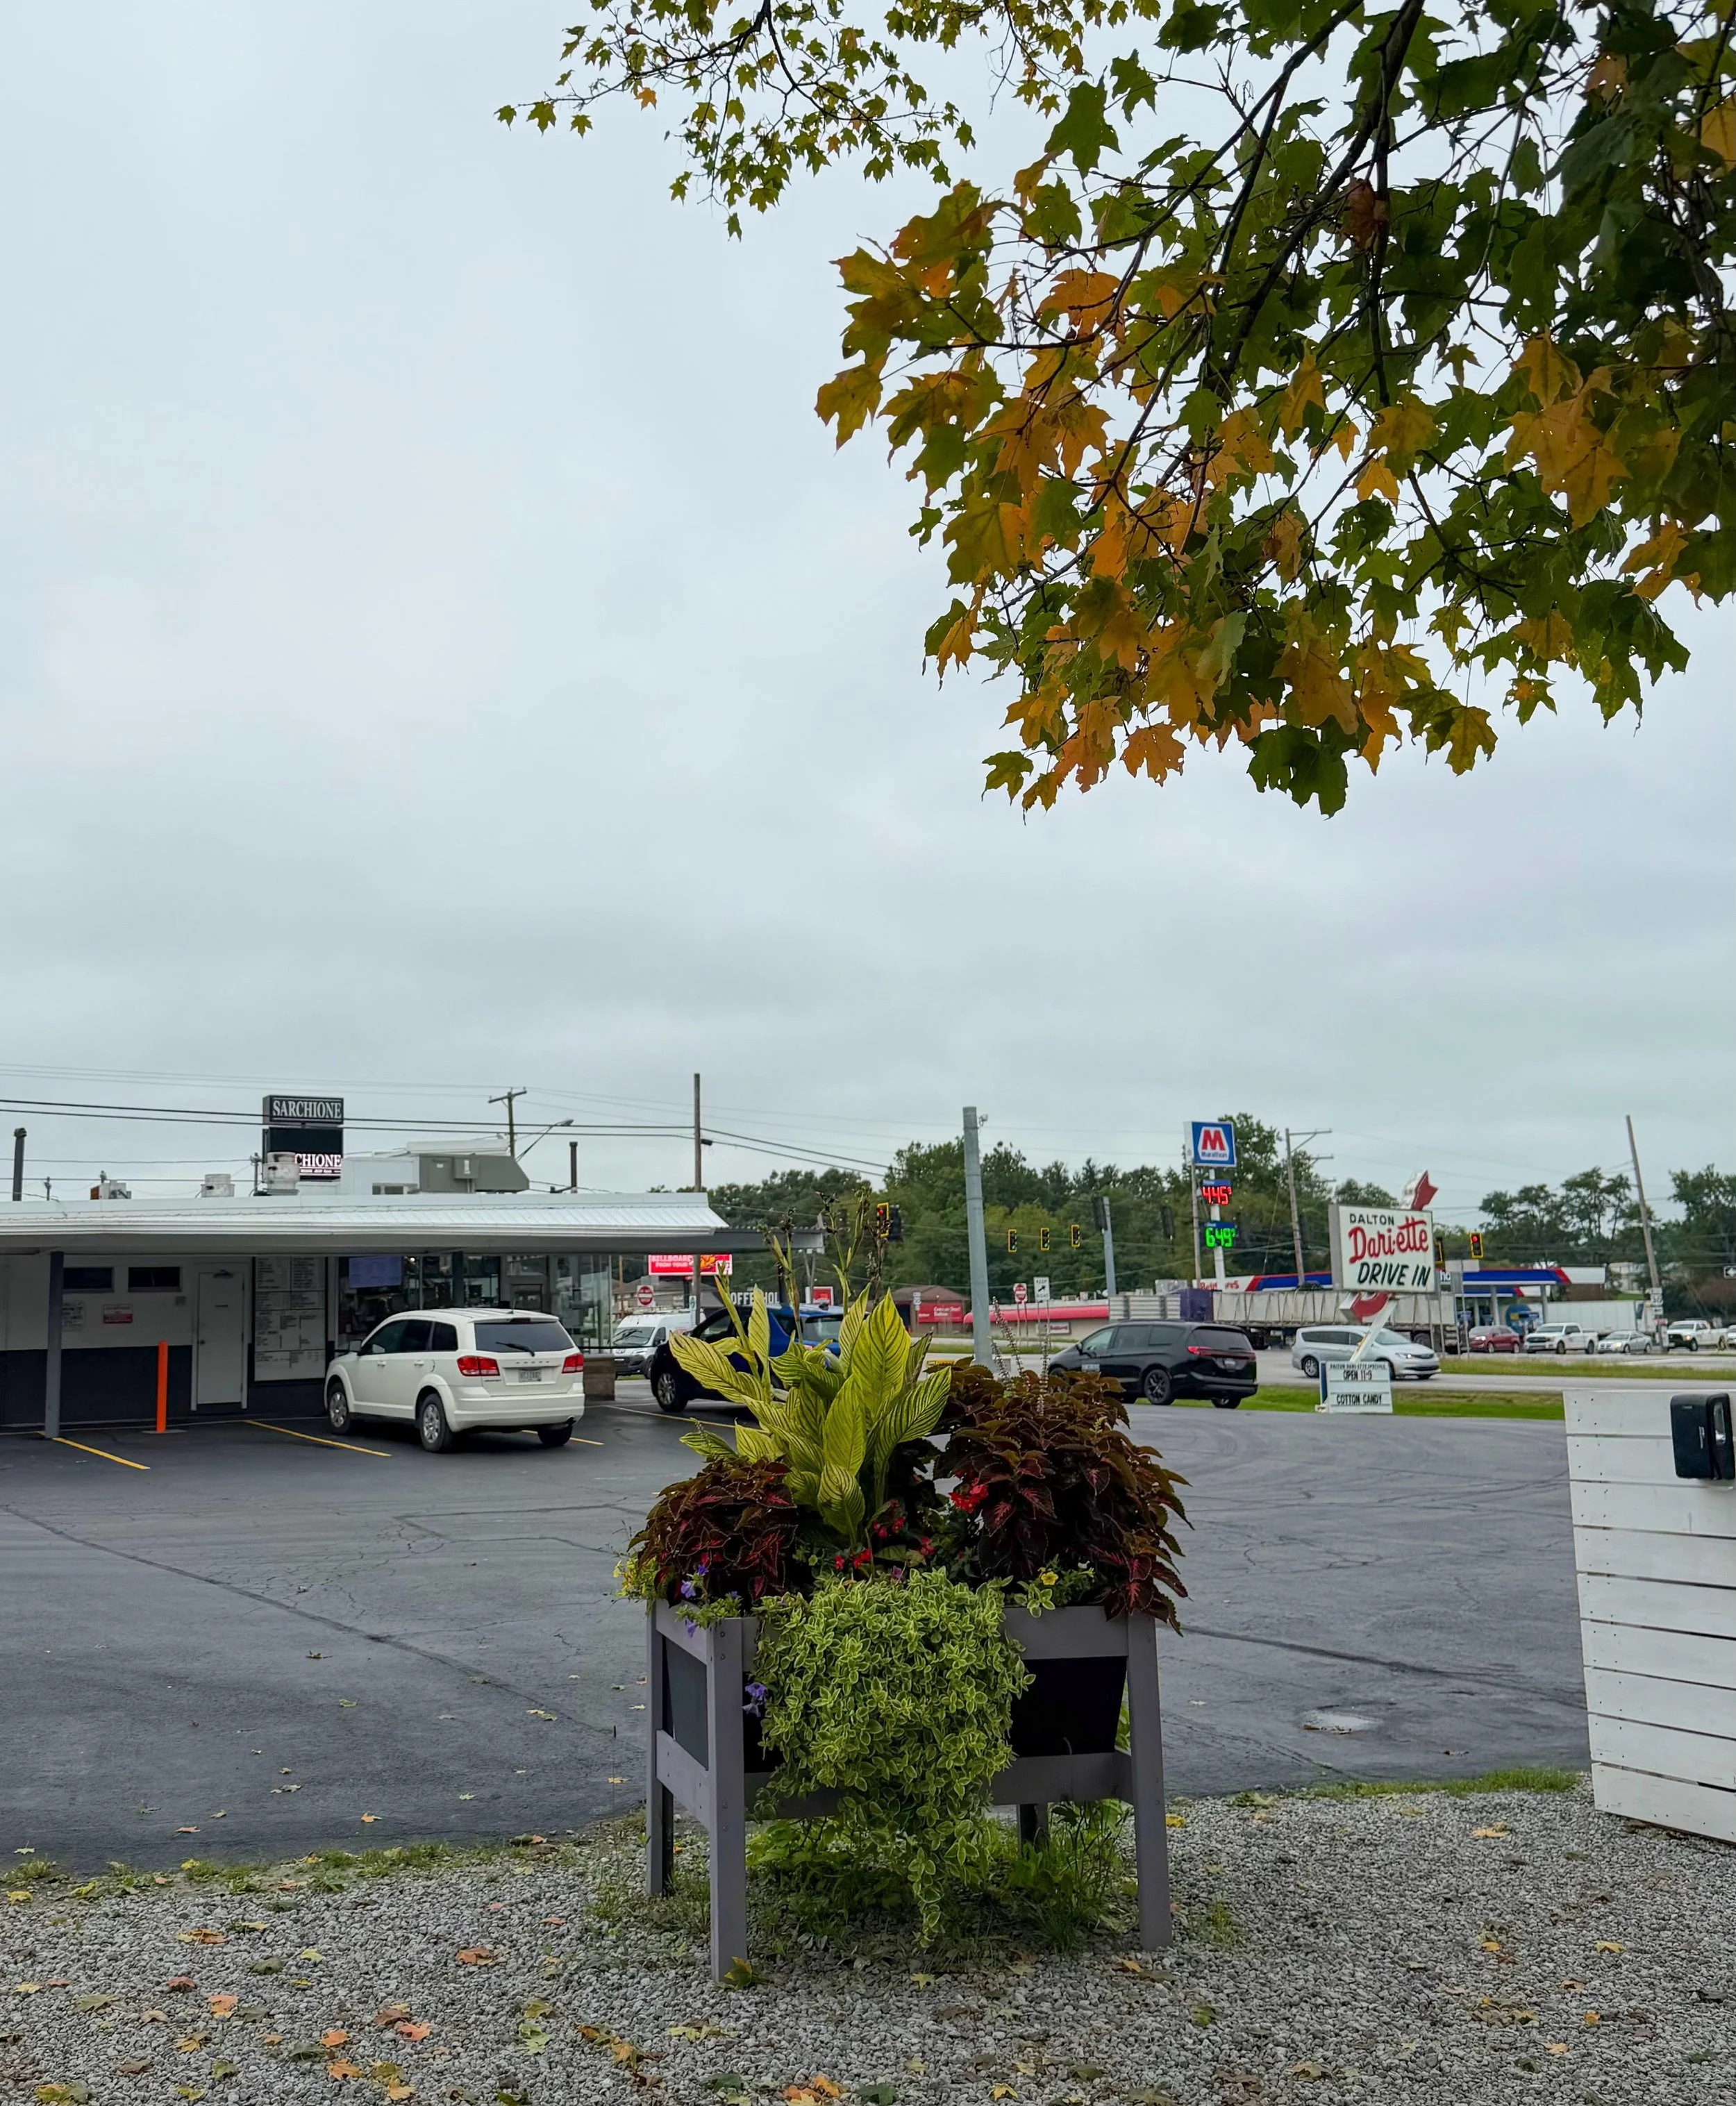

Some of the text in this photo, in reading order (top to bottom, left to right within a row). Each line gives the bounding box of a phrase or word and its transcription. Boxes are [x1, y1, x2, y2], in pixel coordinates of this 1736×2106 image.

[273, 1100, 342, 1119] SARCHIONE
[1202, 1129, 1226, 1151] M
[1349, 1214, 1394, 1226] DALTON
[1357, 1262, 1409, 1285] DRIVE
[1412, 1264, 1431, 1287] IN
[1343, 1370, 1358, 1381] OPEN
[1336, 1394, 1382, 1405] COTTON CANDY
